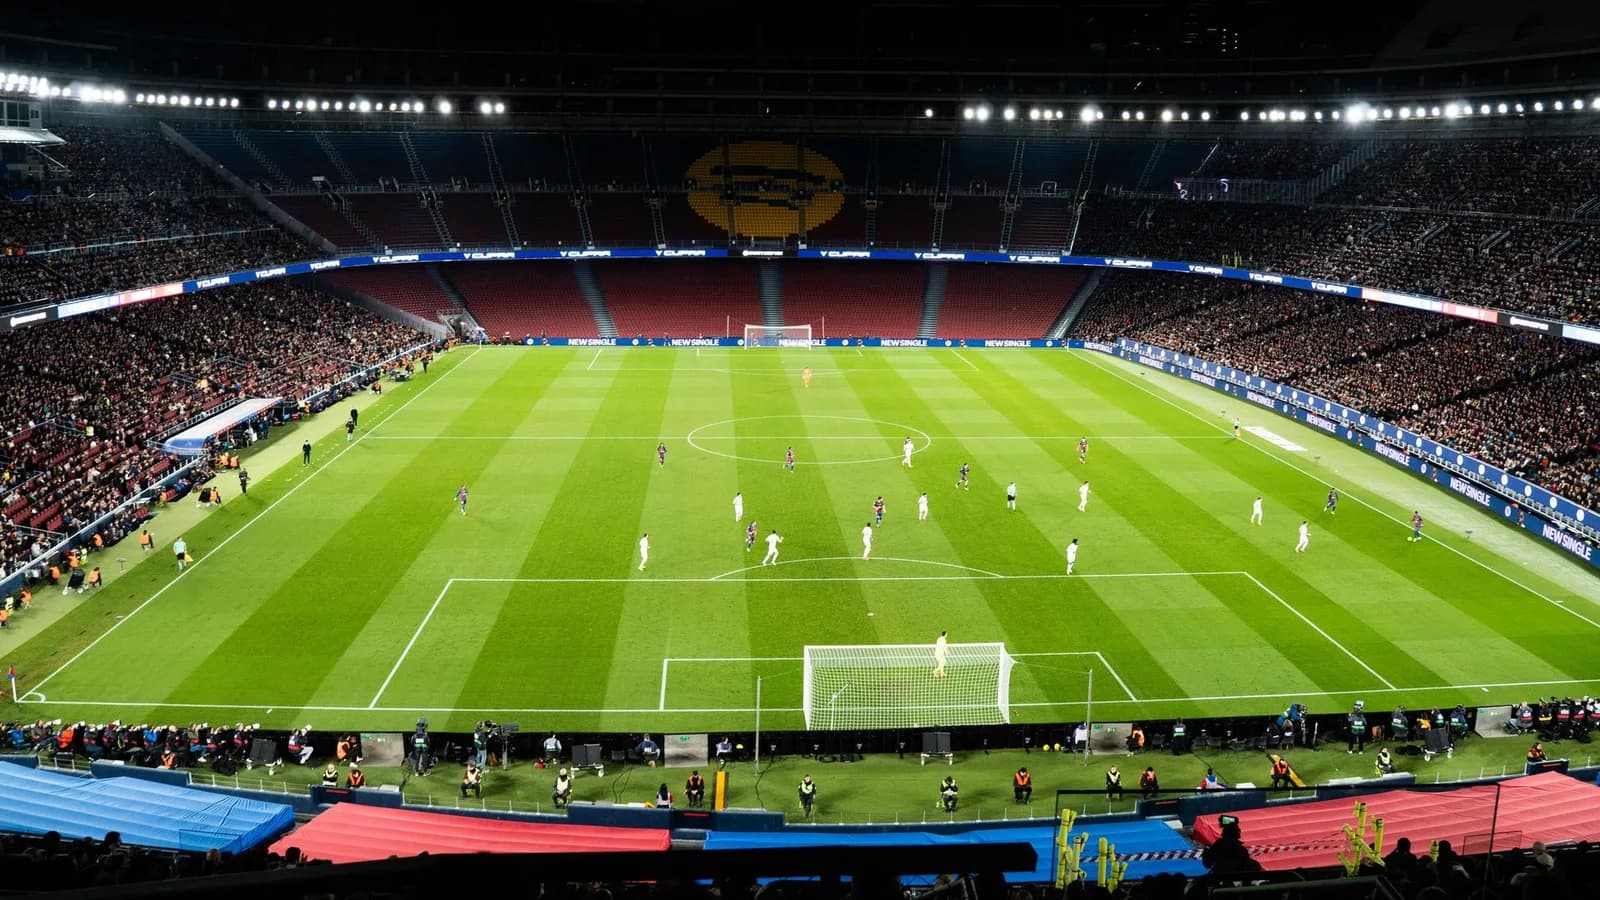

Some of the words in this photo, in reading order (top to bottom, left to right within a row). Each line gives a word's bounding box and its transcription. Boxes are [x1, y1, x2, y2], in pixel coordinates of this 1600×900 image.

[1376, 442, 1389, 456] NEW
[1388, 448, 1410, 466] SINGLE
[1450, 477, 1467, 494] NEW
[1466, 485, 1491, 506] SINGLE
[1542, 524, 1564, 544] NEW
[1561, 532, 1592, 561] SINGLE
